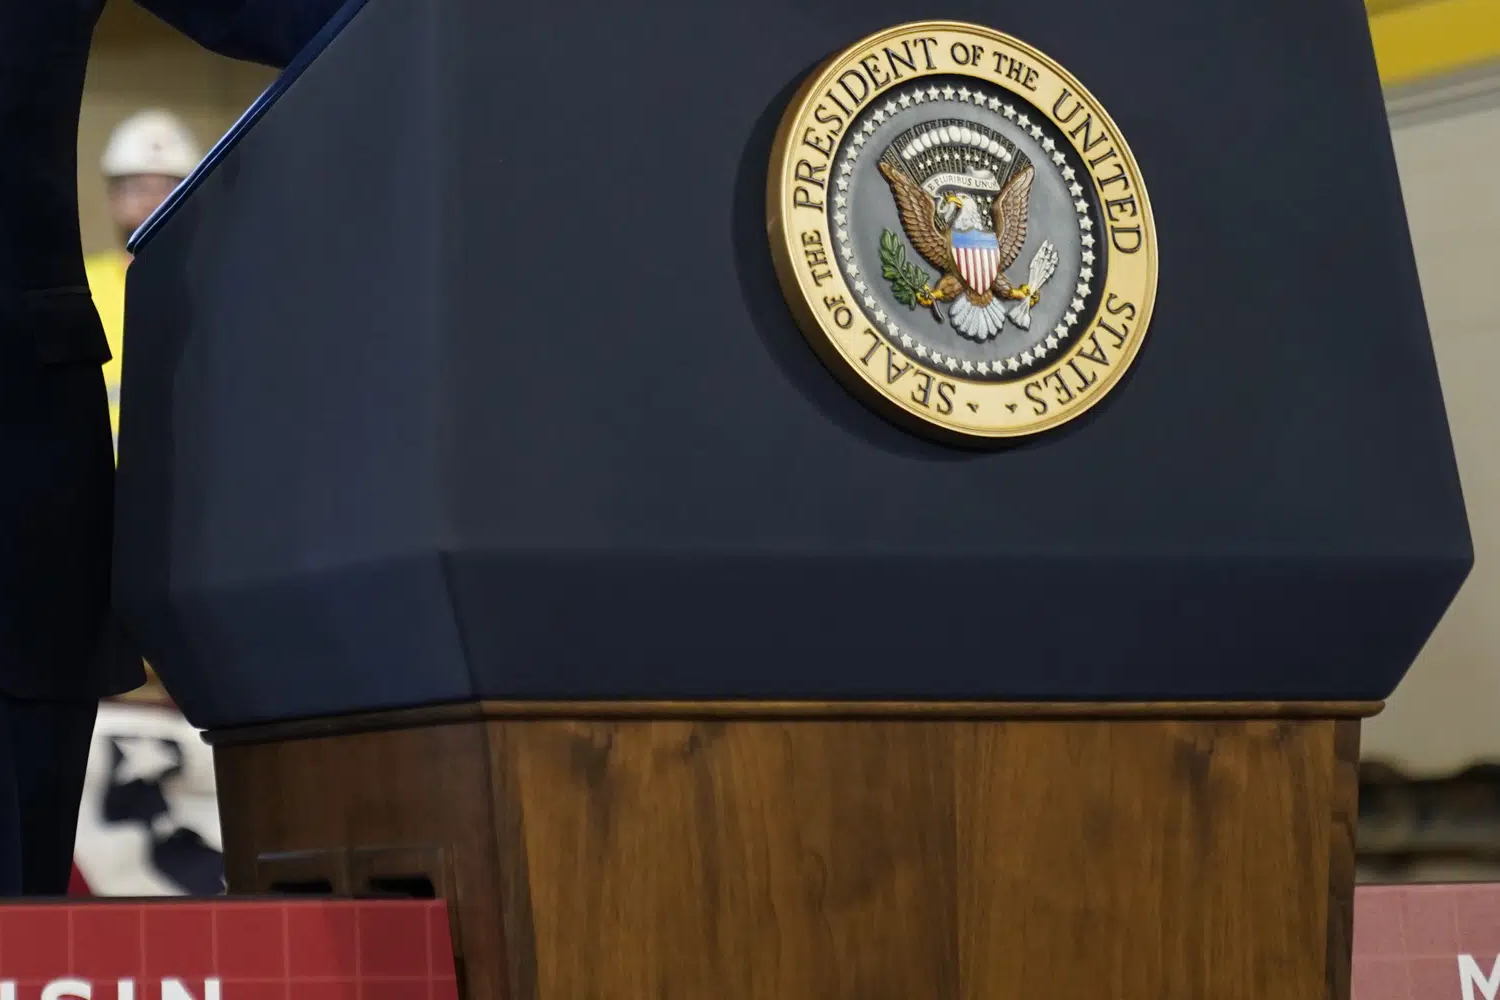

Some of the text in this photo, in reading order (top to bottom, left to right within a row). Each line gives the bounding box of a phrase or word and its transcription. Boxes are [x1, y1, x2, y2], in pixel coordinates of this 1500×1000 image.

[793, 37, 1142, 416] SEAL OF THE PRESIDENT OF THE UNITED STATES
[927, 182, 935, 191] E
